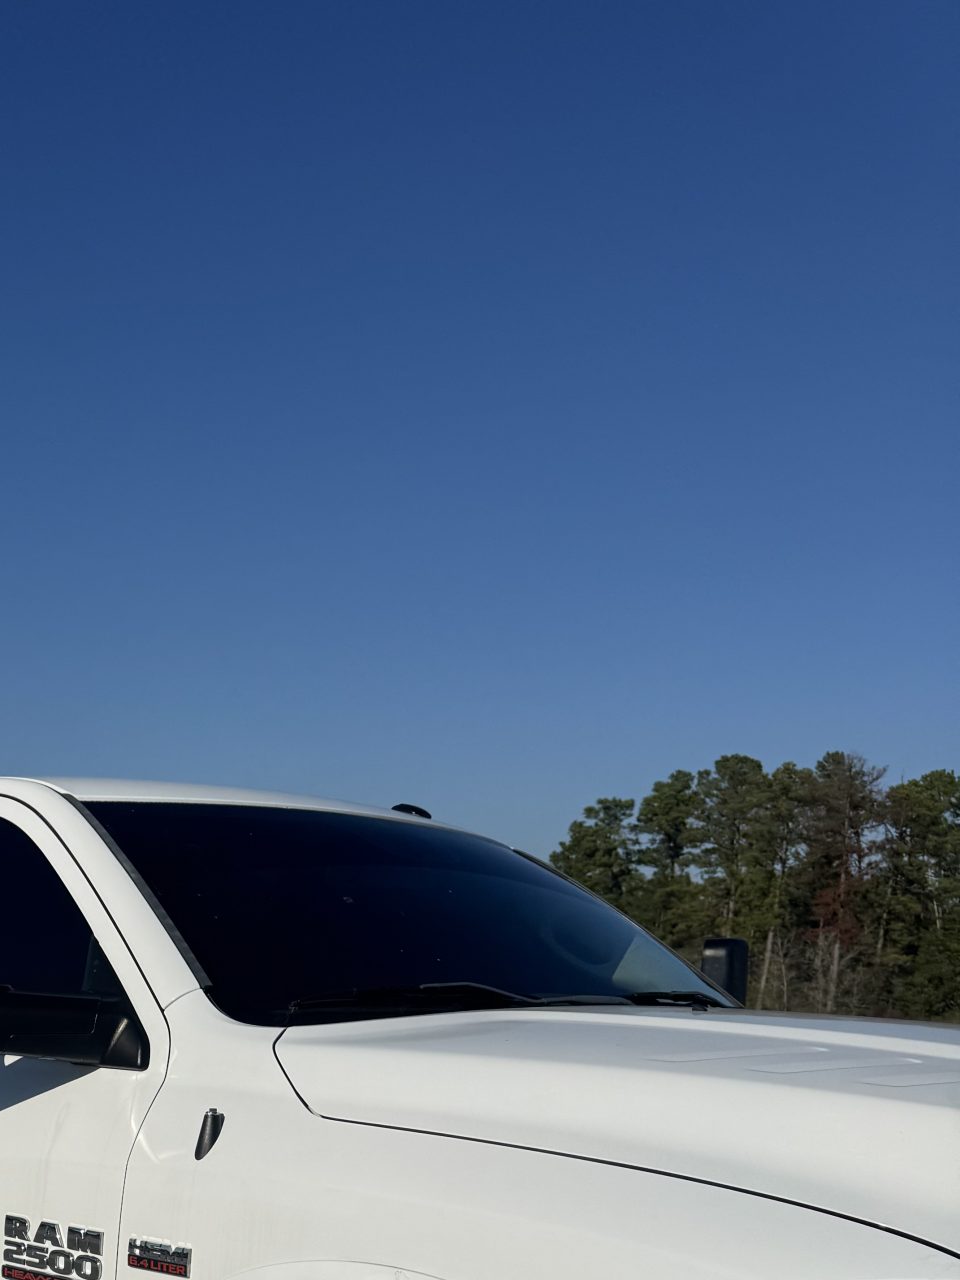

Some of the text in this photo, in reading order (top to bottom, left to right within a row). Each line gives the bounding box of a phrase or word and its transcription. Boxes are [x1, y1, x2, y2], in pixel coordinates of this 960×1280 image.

[4, 1214, 104, 1256] RAM
[3, 1239, 102, 1280] 2500
[129, 1256, 186, 1275] 6.4 LITER
